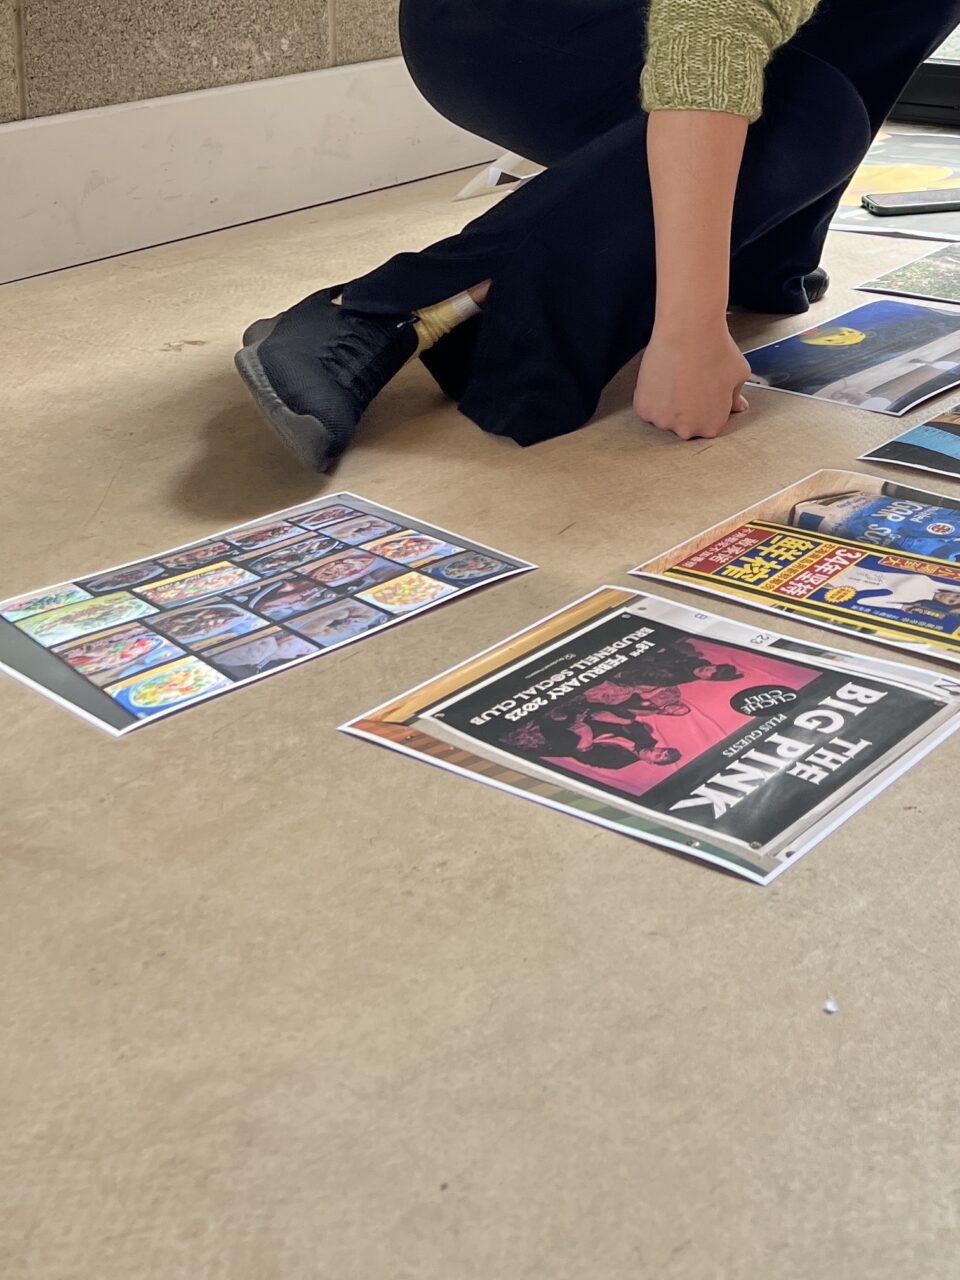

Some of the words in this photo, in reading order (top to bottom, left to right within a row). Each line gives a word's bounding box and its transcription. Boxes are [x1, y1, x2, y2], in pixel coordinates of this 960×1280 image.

[715, 534, 818, 583] 鲜榨
[776, 548, 864, 596] 34年坚持
[567, 626, 656, 671] BRUDENELL
[511, 668, 577, 701] SOCIAL
[540, 653, 631, 700] FEBRUARY
[744, 690, 782, 705] CULT
[465, 698, 520, 726] CLUB
[500, 696, 550, 721] 2023
[756, 713, 789, 732] PLUS
[788, 681, 887, 736] BIG
[718, 729, 765, 757] GUESTS
[781, 731, 874, 785] THE
[665, 732, 816, 824] PINK
